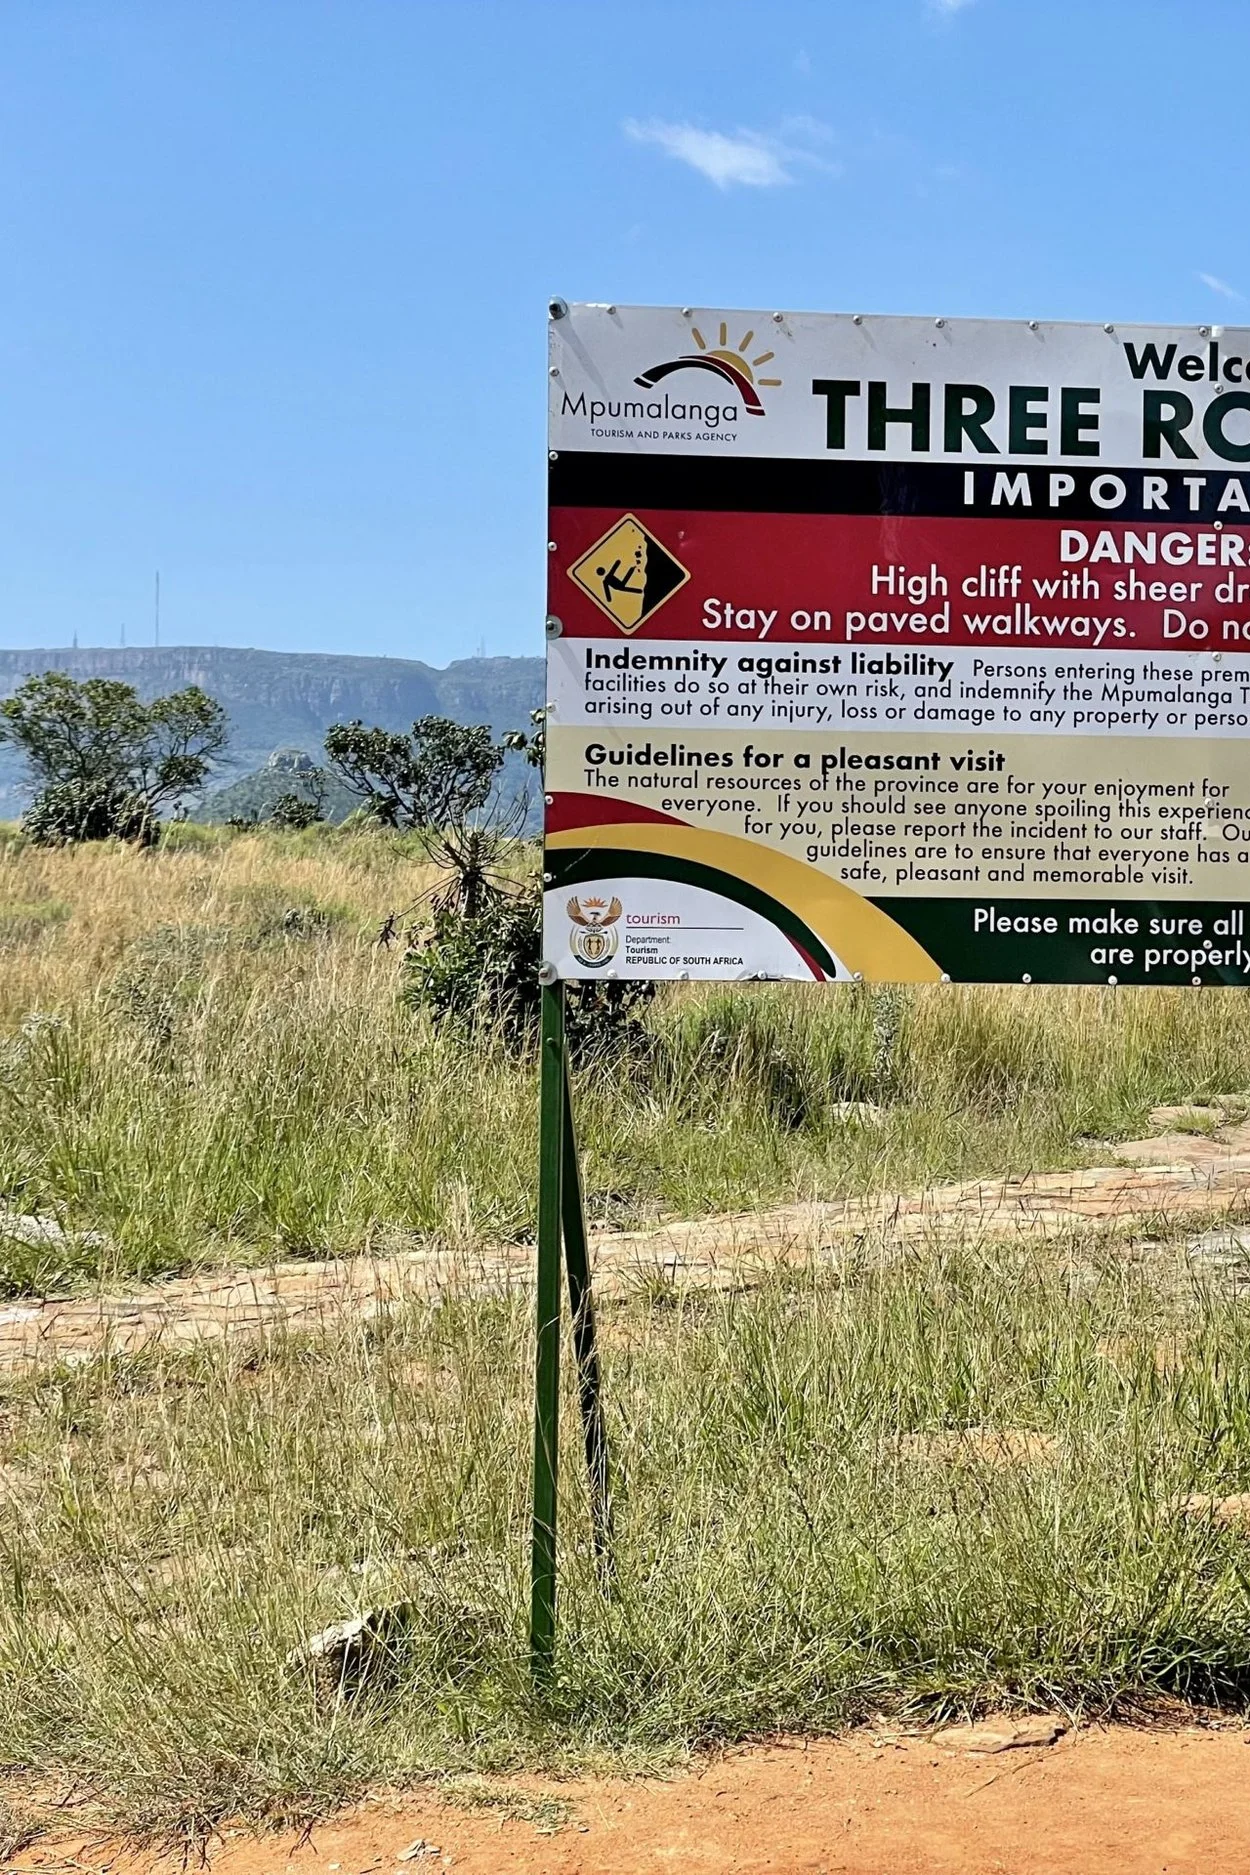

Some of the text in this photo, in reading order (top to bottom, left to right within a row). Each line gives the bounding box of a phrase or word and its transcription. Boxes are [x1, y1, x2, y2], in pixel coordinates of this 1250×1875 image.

[561, 391, 738, 428] Mpumalanga
[812, 379, 1100, 457] THREE
[589, 425, 737, 441] TOURISM AND PARKS AGENCY
[871, 563, 947, 606] High
[961, 565, 1021, 599] cliff
[1032, 567, 1099, 601] with
[1113, 569, 1202, 604] sheer
[702, 597, 777, 640] Stay
[790, 608, 831, 633] on
[846, 601, 949, 642] paved
[963, 603, 1135, 647] walkways.
[1163, 606, 1208, 640] Do
[586, 646, 727, 677] Indemnity
[737, 650, 841, 678] against
[851, 652, 954, 682] liability
[973, 654, 1046, 678] Persons
[1054, 657, 1134, 686] entering
[1142, 658, 1193, 681] these
[584, 671, 666, 693] facilities
[674, 673, 699, 694] do
[708, 679, 729, 694] so
[737, 676, 757, 695] at
[763, 675, 809, 696] their
[816, 681, 857, 697] own
[865, 676, 905, 702] risk,
[914, 678, 951, 698] and
[960, 678, 1056, 706] indemnify
[1062, 680, 1092, 701] the
[1101, 681, 1232, 709] Mpumalanga
[584, 742, 1005, 775] Guidelines for a pleasant visit
[584, 768, 1230, 802] The natural resources of the province are for your enjoyment for
[661, 797, 761, 818] everyone.
[777, 793, 790, 813] If
[796, 798, 833, 819] you
[841, 794, 905, 814] should
[913, 800, 946, 815] see
[954, 800, 1027, 821] anyone
[1035, 797, 1110, 823] spoiling
[1118, 798, 1150, 818] this
[806, 839, 1248, 868] guidelines are to ensure that everyone has a
[840, 860, 1193, 887] safe, pleasant and memorable visit.
[626, 912, 680, 925] tourism
[974, 906, 1058, 933] Please
[1068, 908, 1138, 934] make
[1149, 917, 1202, 935] sure
[1213, 909, 1243, 935] all
[625, 945, 658, 954] Tourism
[625, 956, 743, 965] REPUBLIC OF SOUTH AFRICA
[1090, 946, 1134, 964] are
